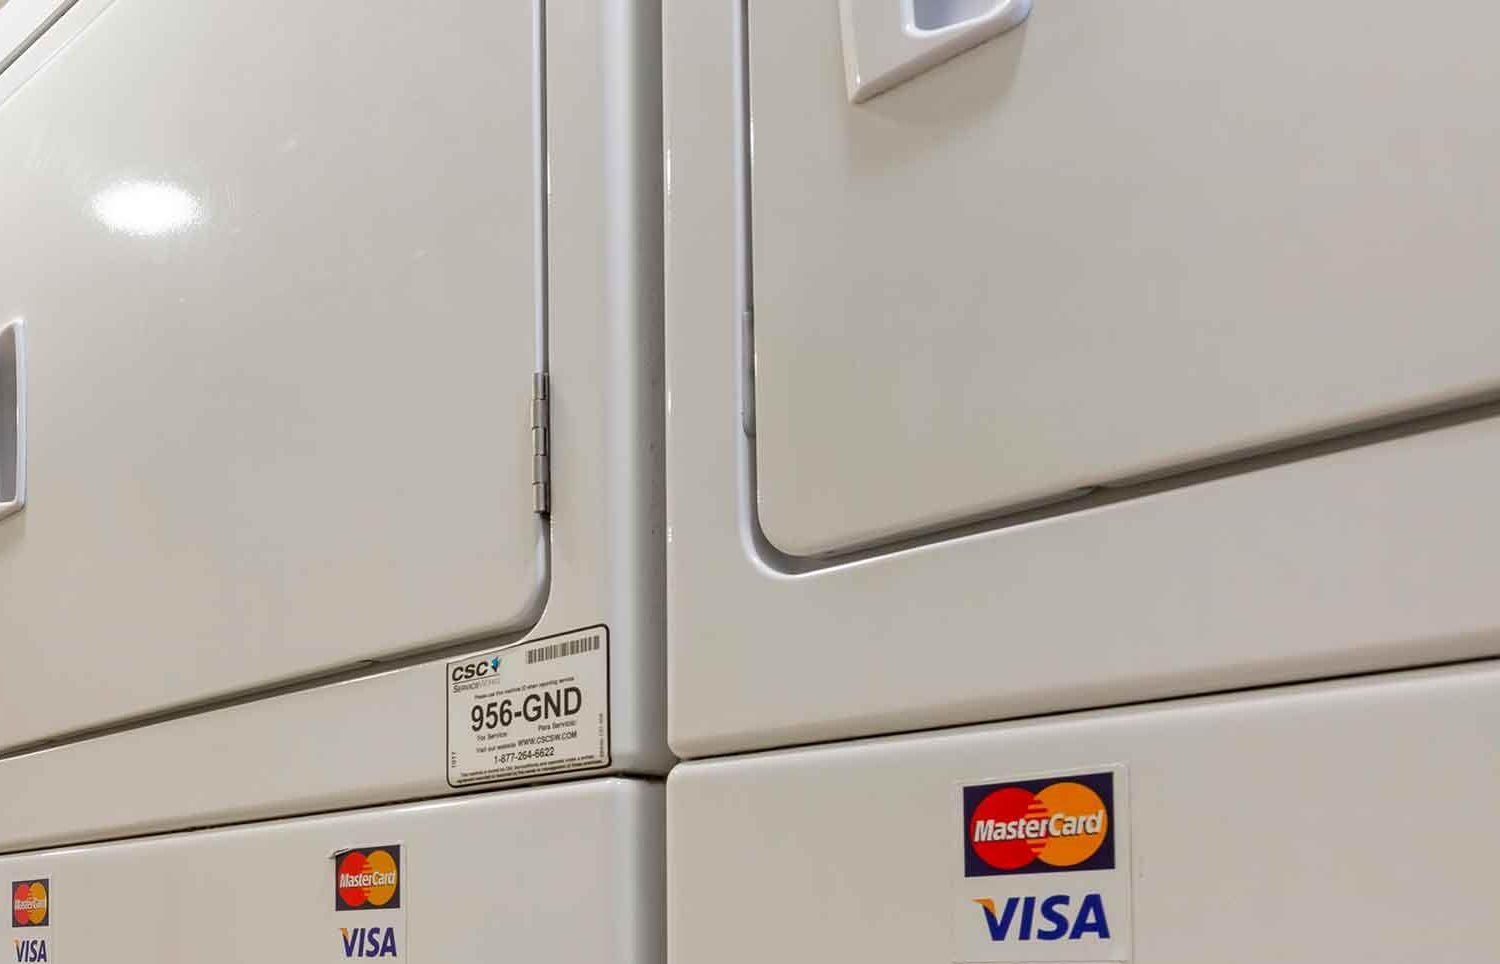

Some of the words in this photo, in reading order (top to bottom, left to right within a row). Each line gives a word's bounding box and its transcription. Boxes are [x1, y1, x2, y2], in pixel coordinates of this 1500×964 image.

[451, 661, 489, 681] CSC
[471, 686, 582, 732] 956-GND
[973, 810, 1103, 843] MasterCard
[339, 870, 397, 888] MasterCard
[13, 896, 47, 911] MasterCard
[972, 894, 1110, 941] VISA
[15, 939, 47, 963] VISA
[339, 927, 397, 957] VISA
